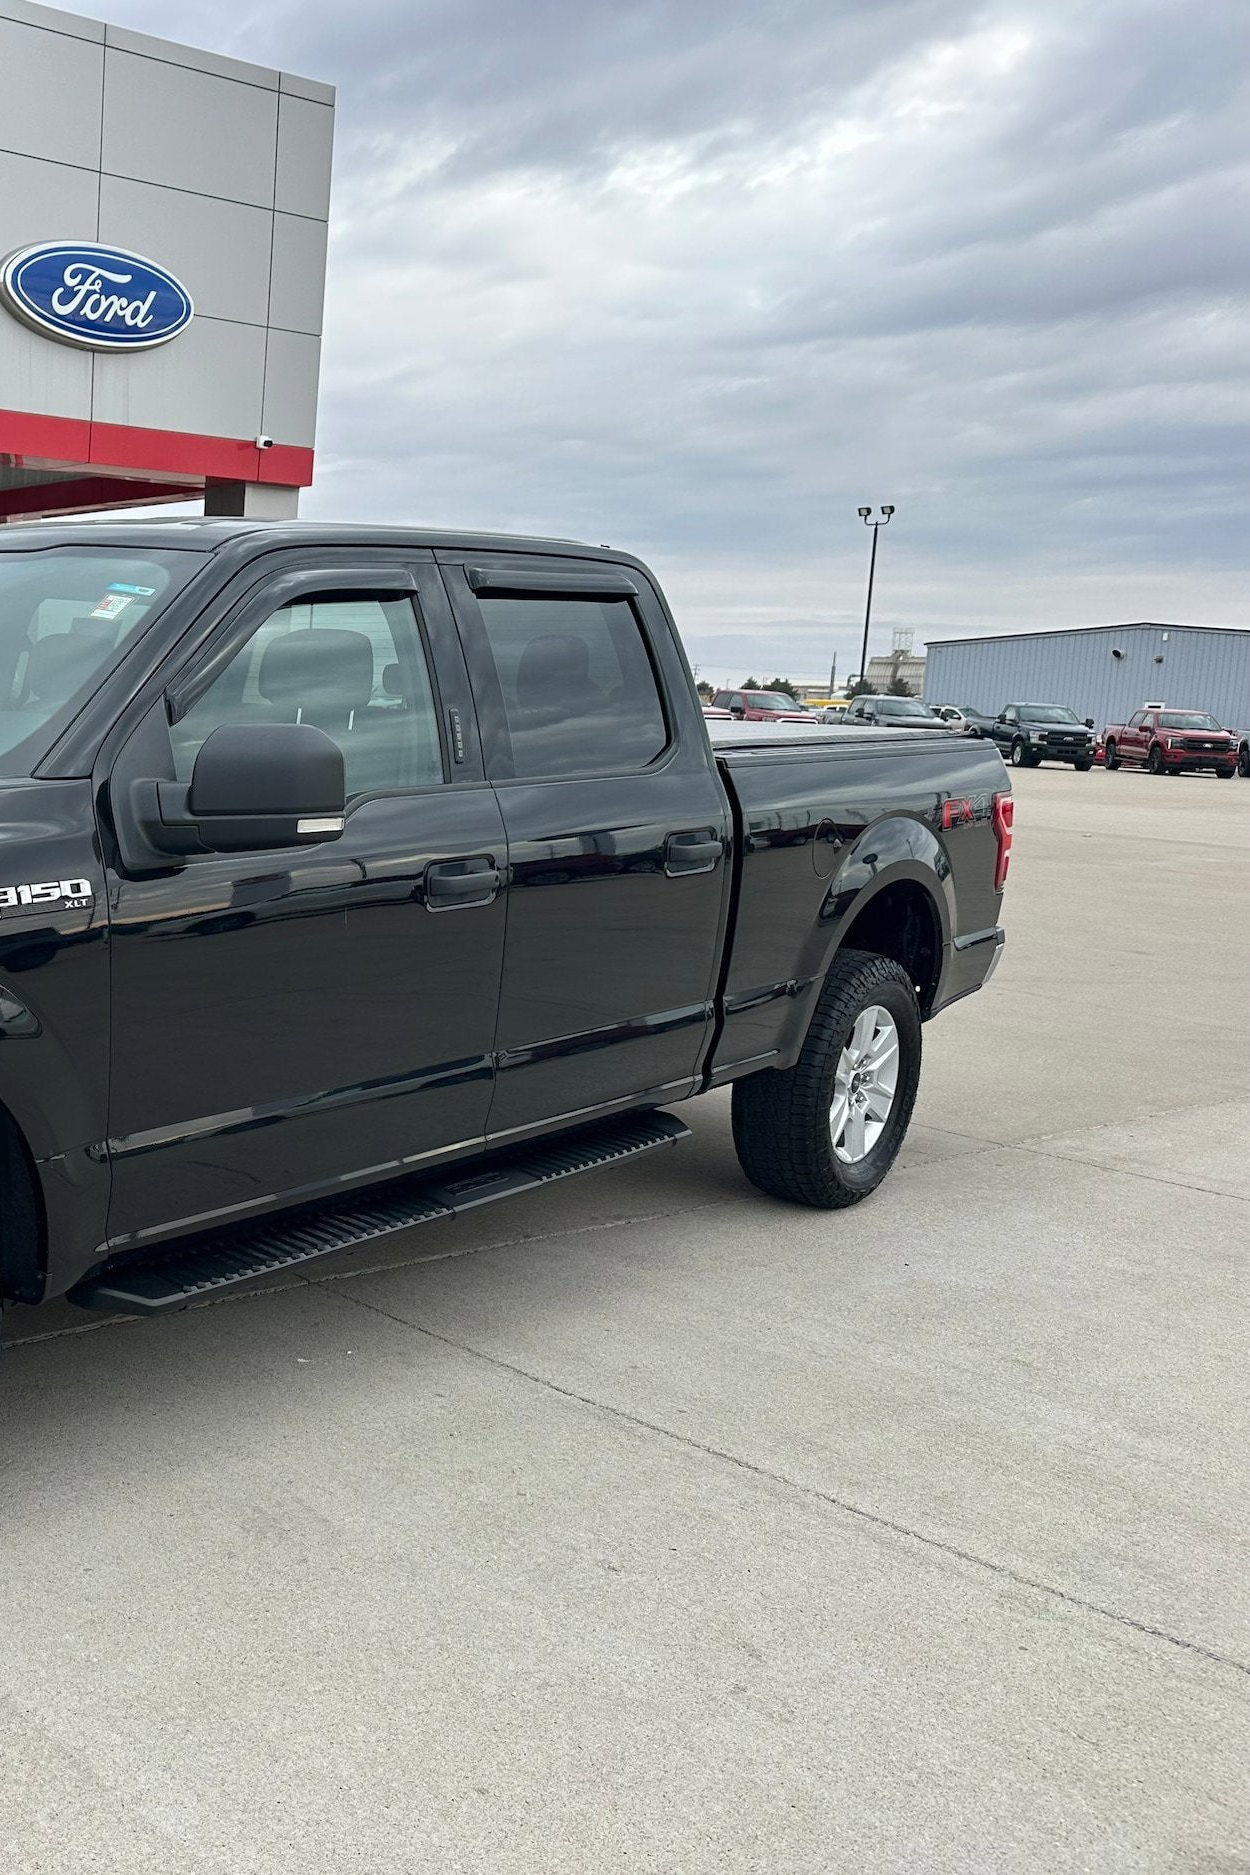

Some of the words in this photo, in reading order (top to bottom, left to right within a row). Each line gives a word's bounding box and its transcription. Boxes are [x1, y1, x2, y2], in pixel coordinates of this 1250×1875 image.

[51, 262, 157, 329] Ford
[941, 793, 991, 831] FX4
[63, 898, 89, 909] XLT
